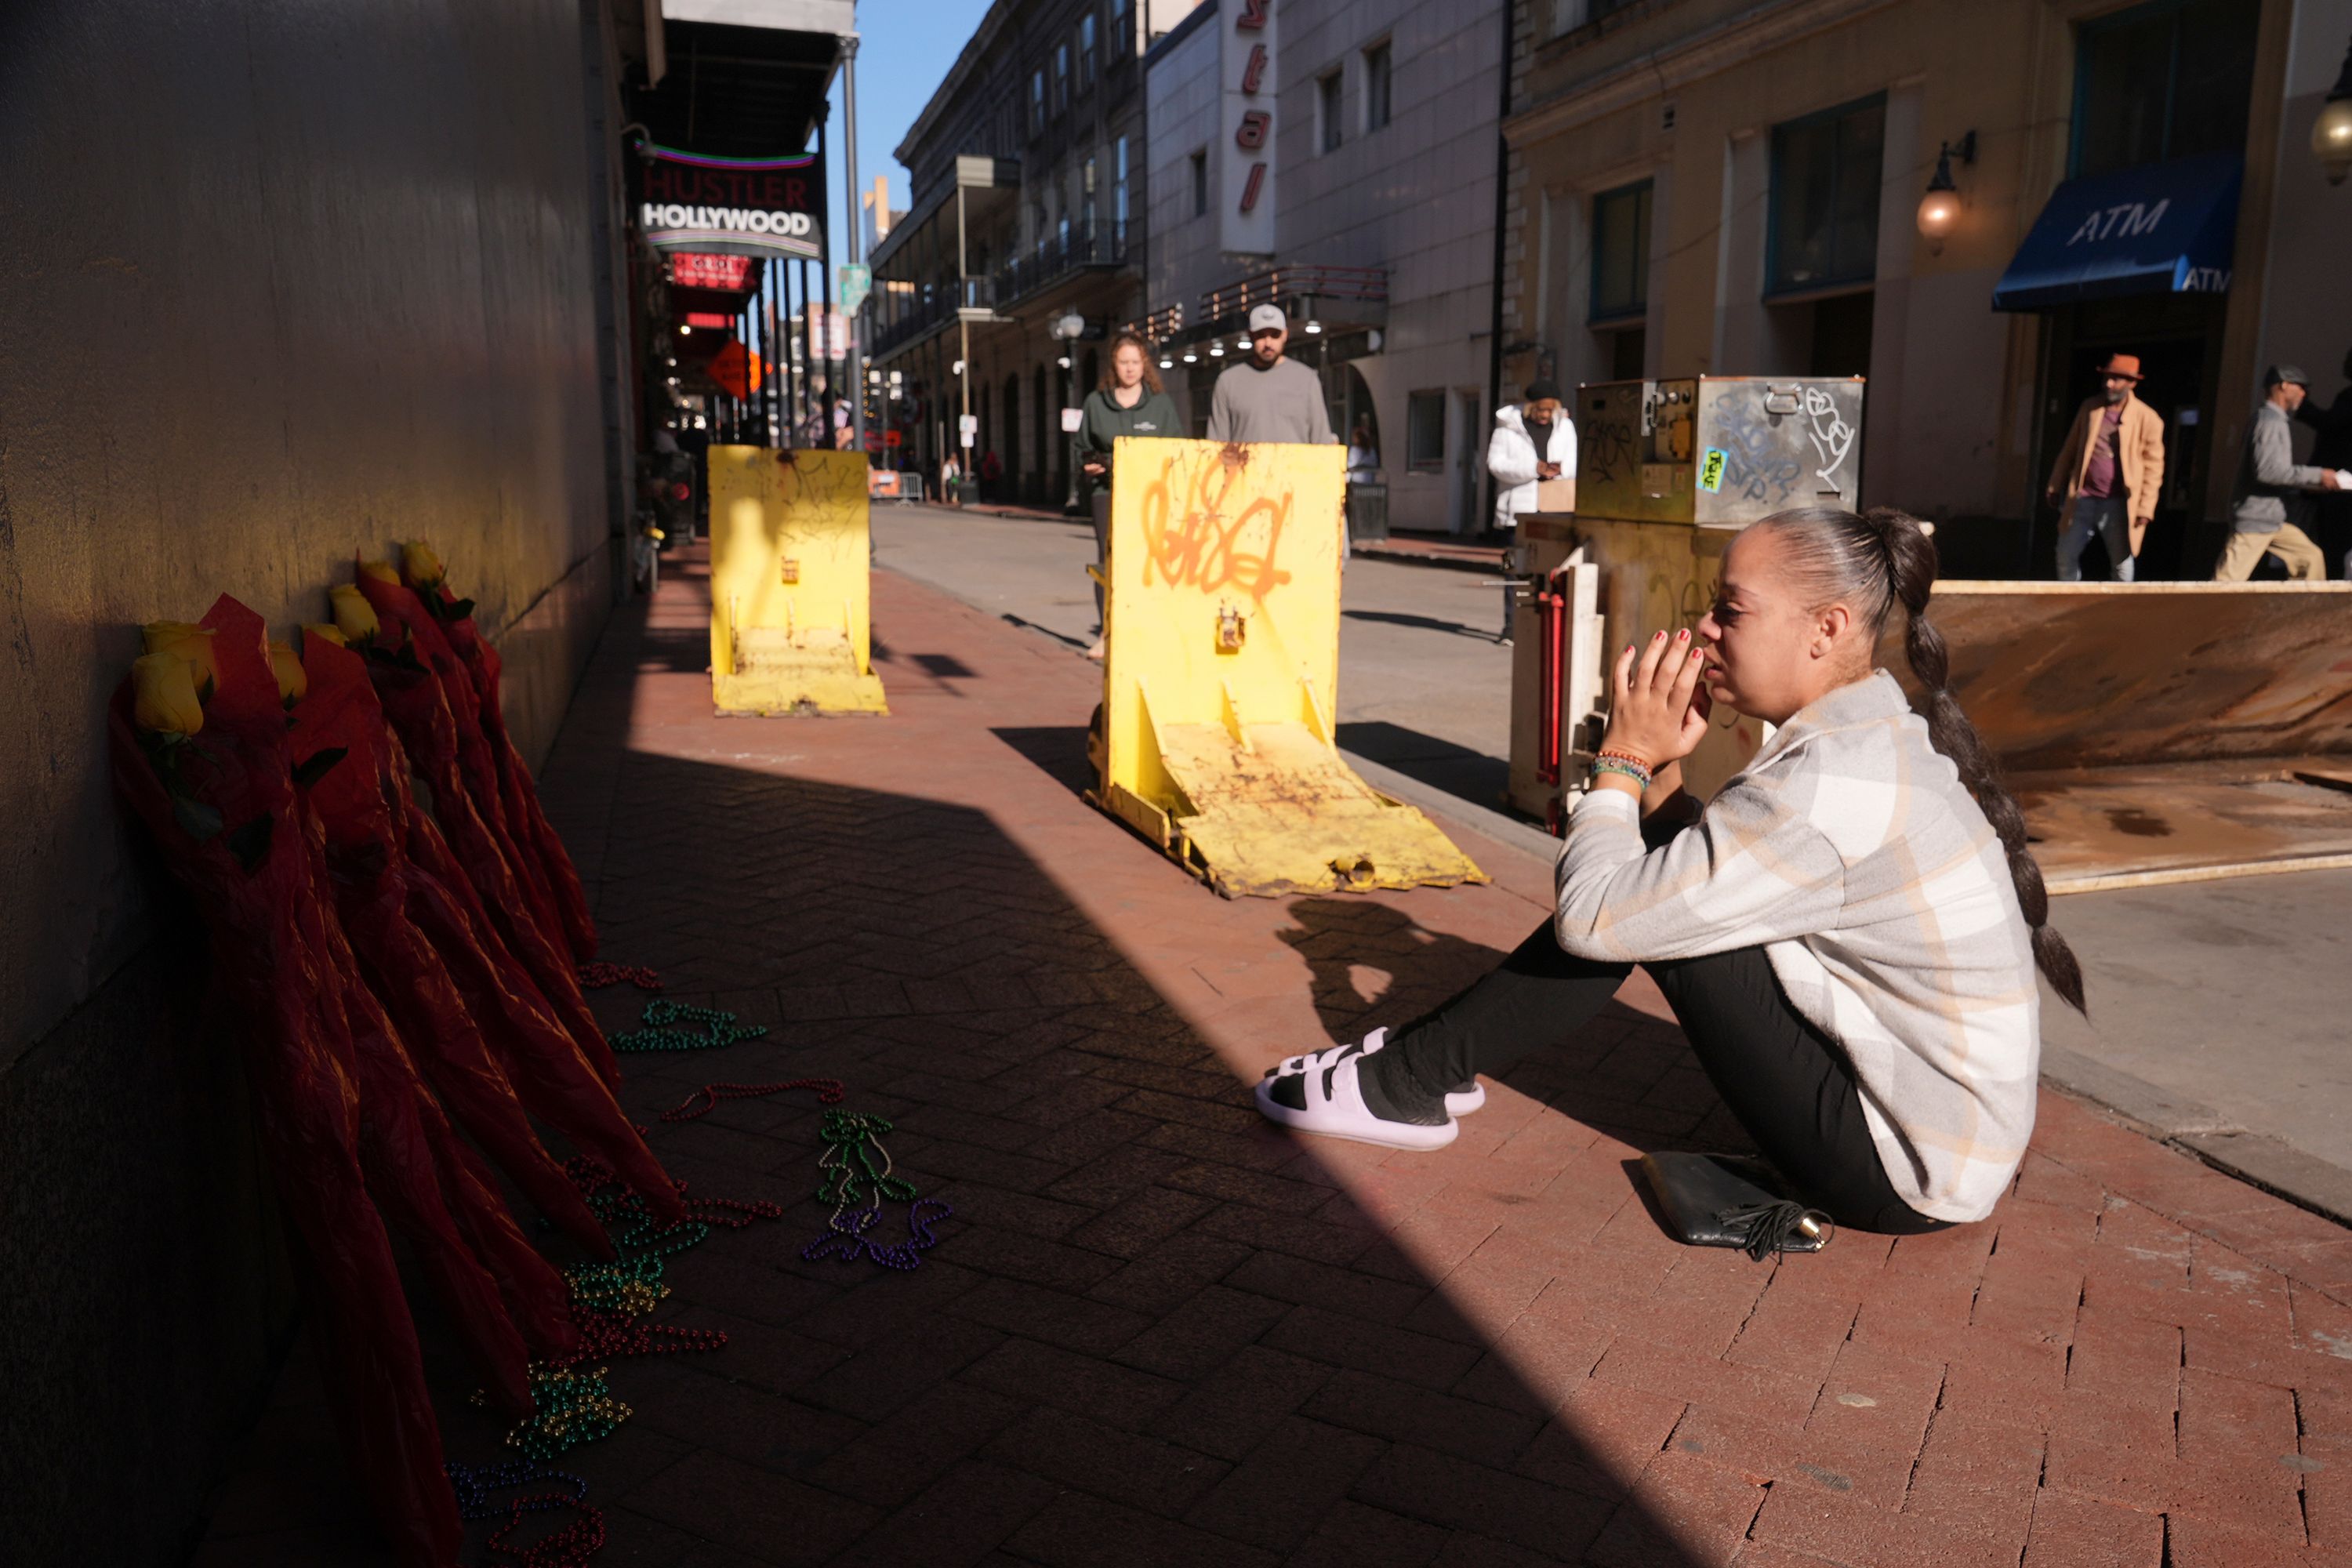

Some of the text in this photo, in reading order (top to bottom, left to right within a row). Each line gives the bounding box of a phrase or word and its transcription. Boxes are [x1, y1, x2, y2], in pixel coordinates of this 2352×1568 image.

[643, 167, 807, 208] HUSTLER
[643, 202, 811, 235] HOLLYWOOD
[2067, 198, 2171, 246] ATM
